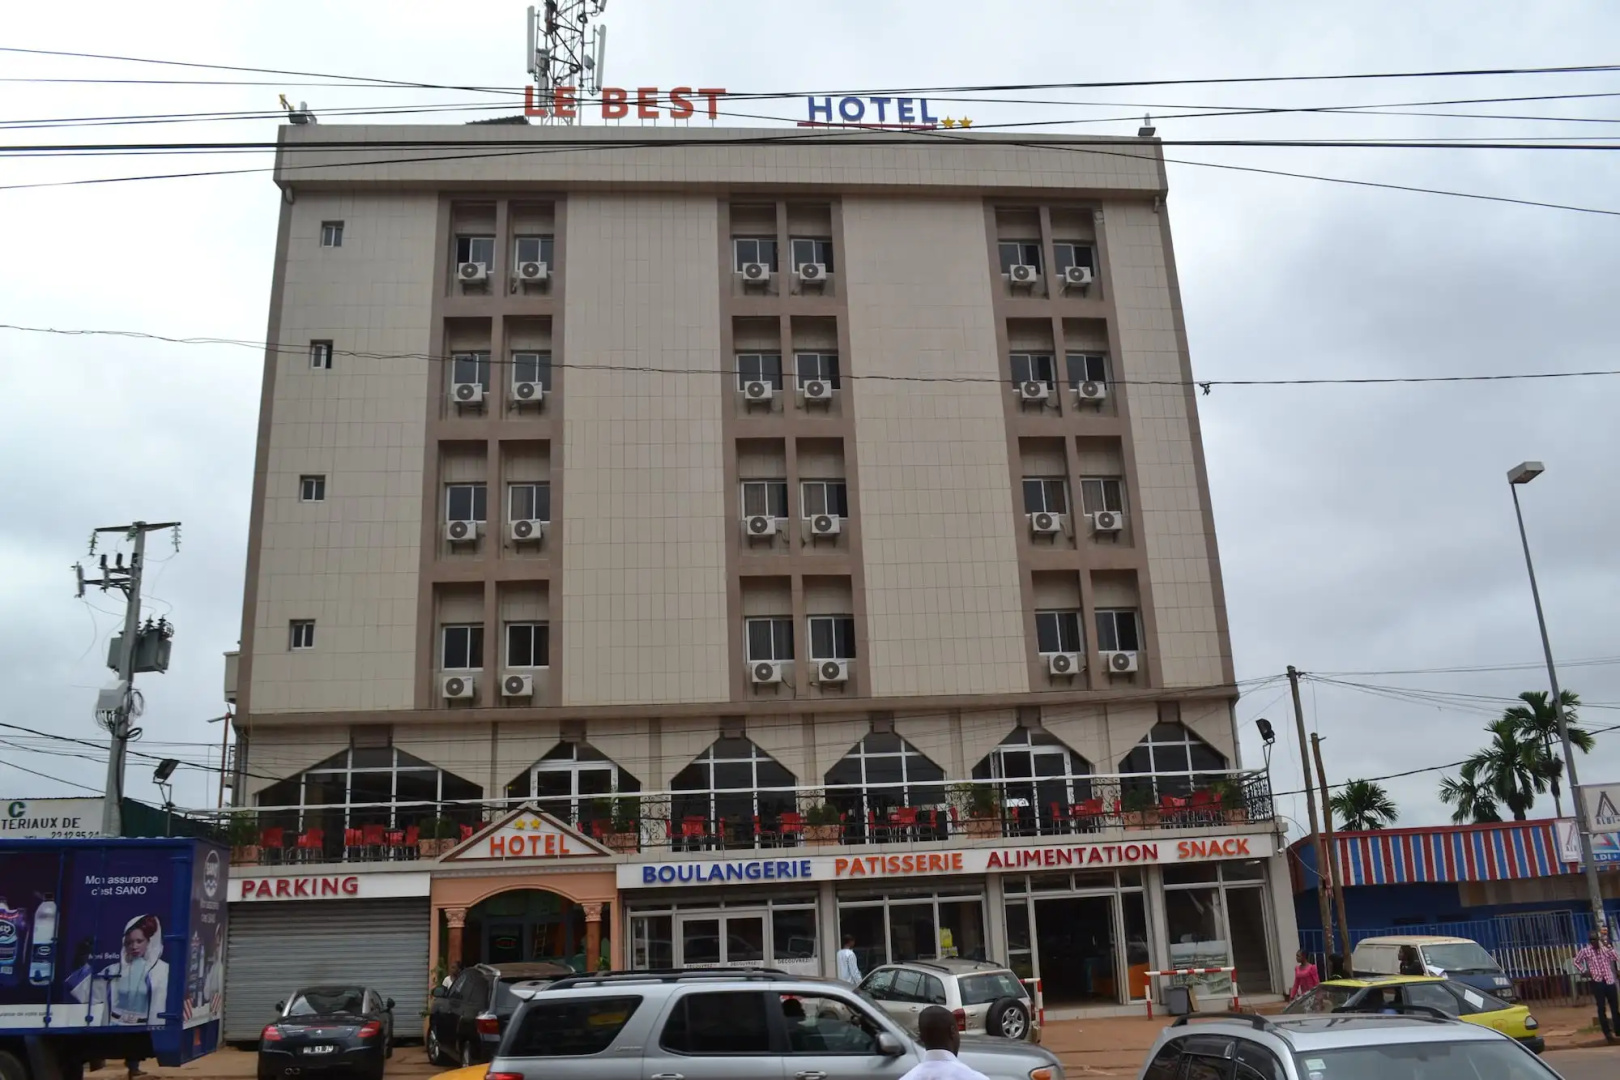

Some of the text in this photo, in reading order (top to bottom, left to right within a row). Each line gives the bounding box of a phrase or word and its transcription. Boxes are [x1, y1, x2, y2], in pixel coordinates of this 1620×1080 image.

[525, 86, 726, 119] LE BEST
[808, 96, 938, 123] HOTEL
[62, 817, 81, 829] DE
[489, 833, 570, 857] HOTEL
[642, 838, 1250, 884] BOULANGERIE PATISSERIE ALIMENTATION SNACK
[1593, 853, 1612, 861] LDI
[85, 875, 159, 885] Mon assurance
[114, 885, 147, 895] SANO
[241, 876, 359, 899] PARKING
